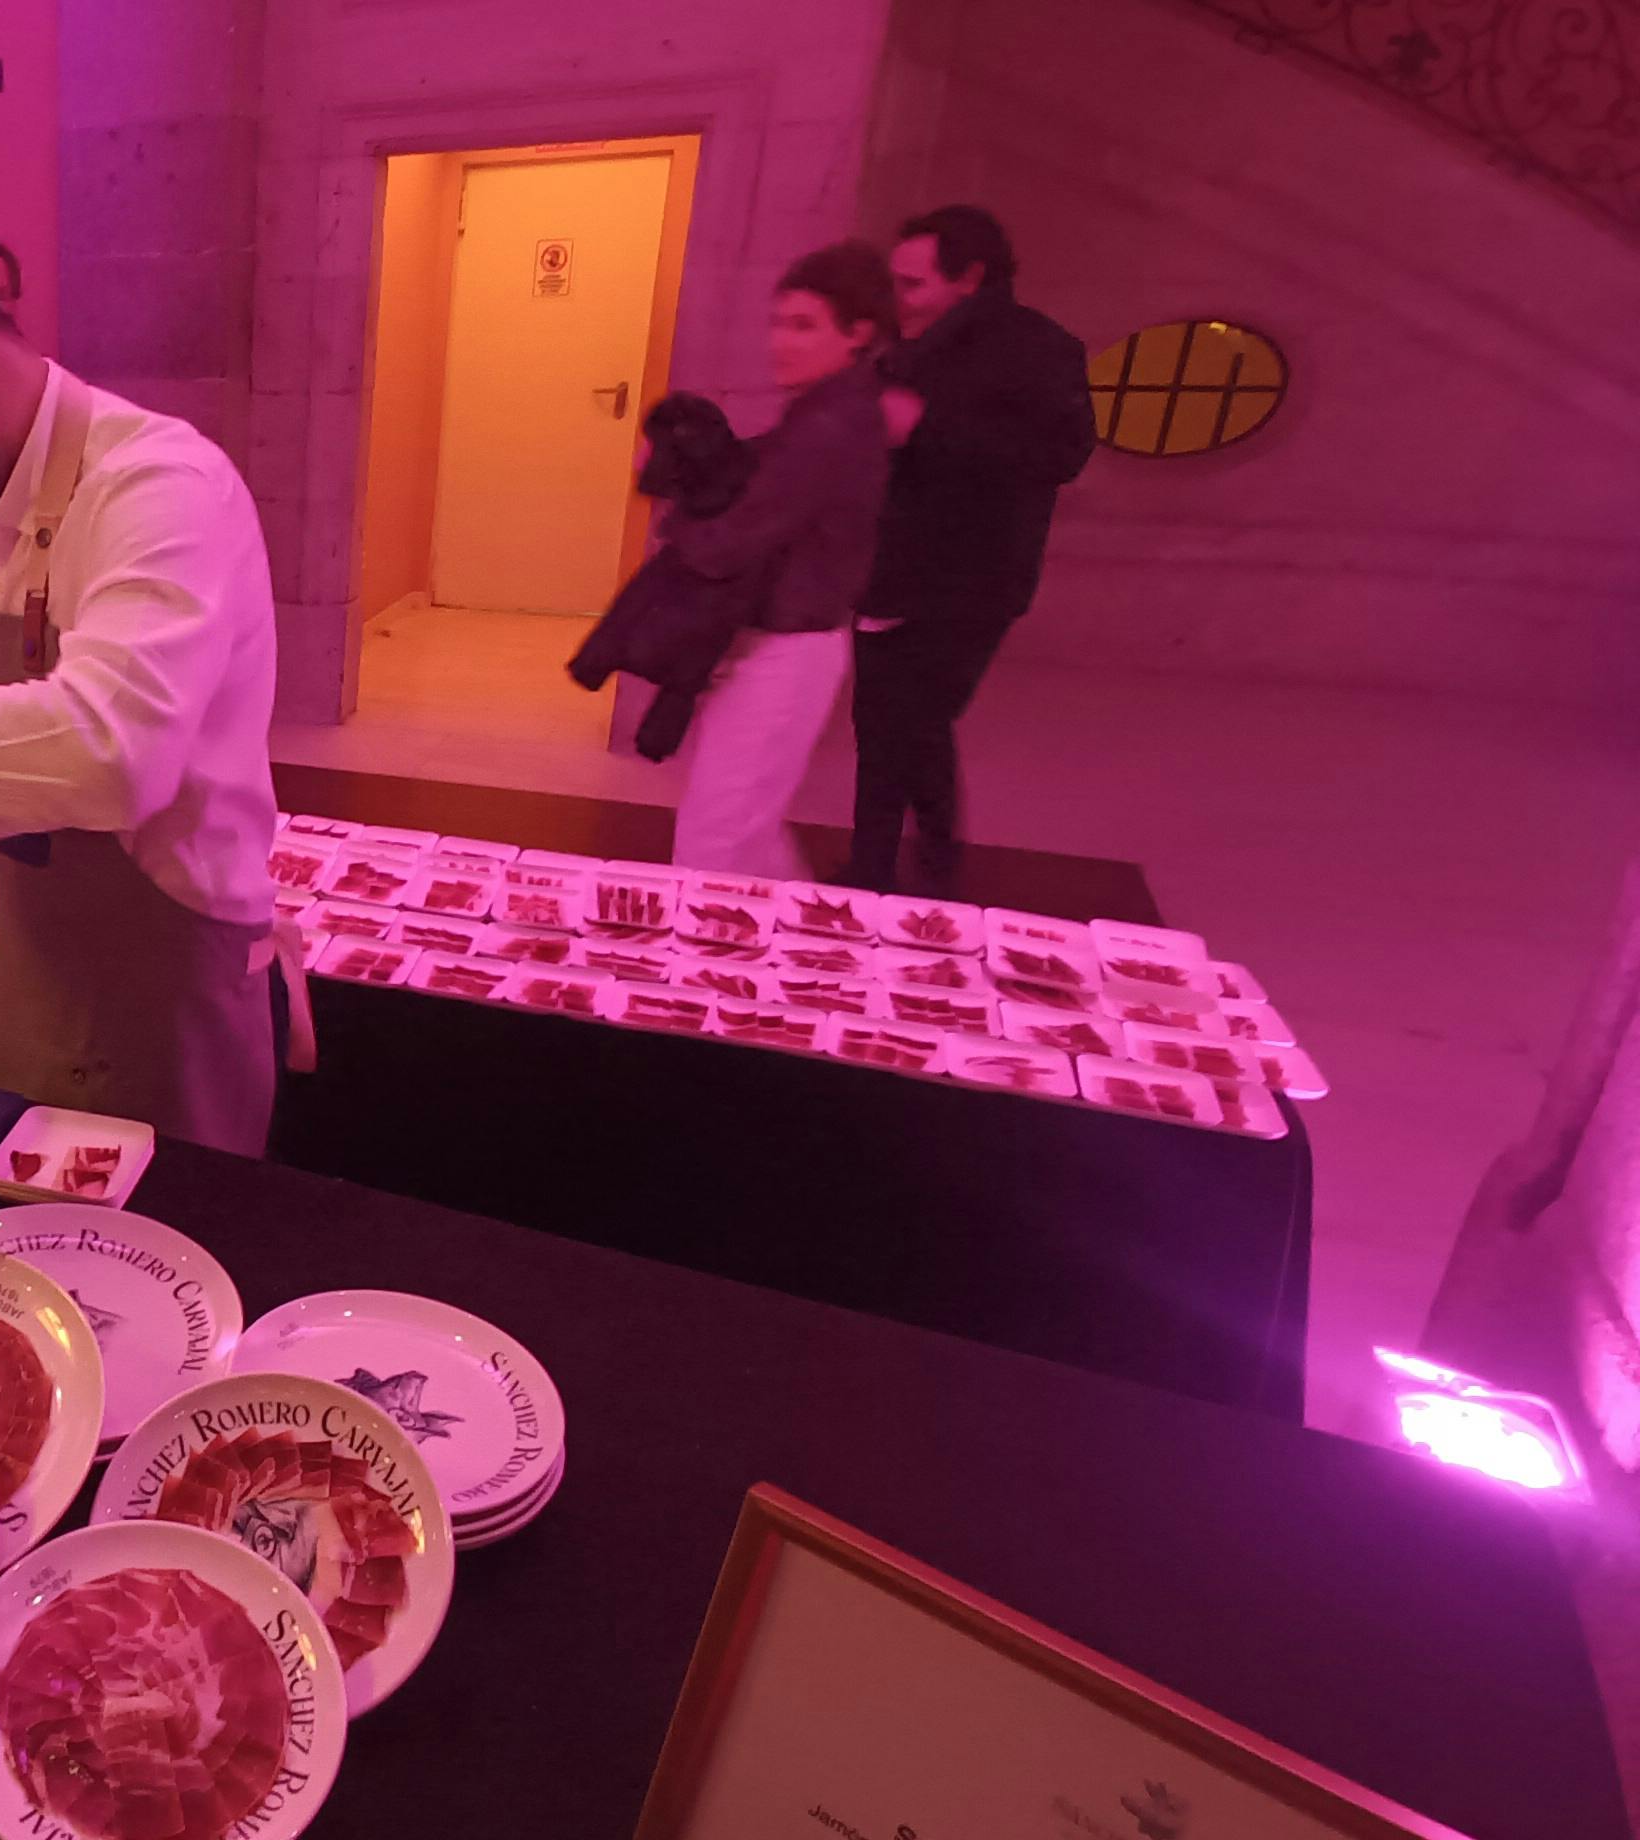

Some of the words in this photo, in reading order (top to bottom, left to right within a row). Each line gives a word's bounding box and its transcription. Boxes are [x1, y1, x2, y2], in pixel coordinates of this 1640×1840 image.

[76, 1228, 176, 1283] ROMERO
[173, 1280, 210, 1376] CARVAJAL
[481, 1352, 539, 1441] SANCHEZ
[190, 1401, 310, 1442] ROMERO
[321, 1405, 421, 1516] CARVAJAL
[451, 1447, 544, 1502] ROMERO
[263, 1609, 315, 1755] SANCHEZ
